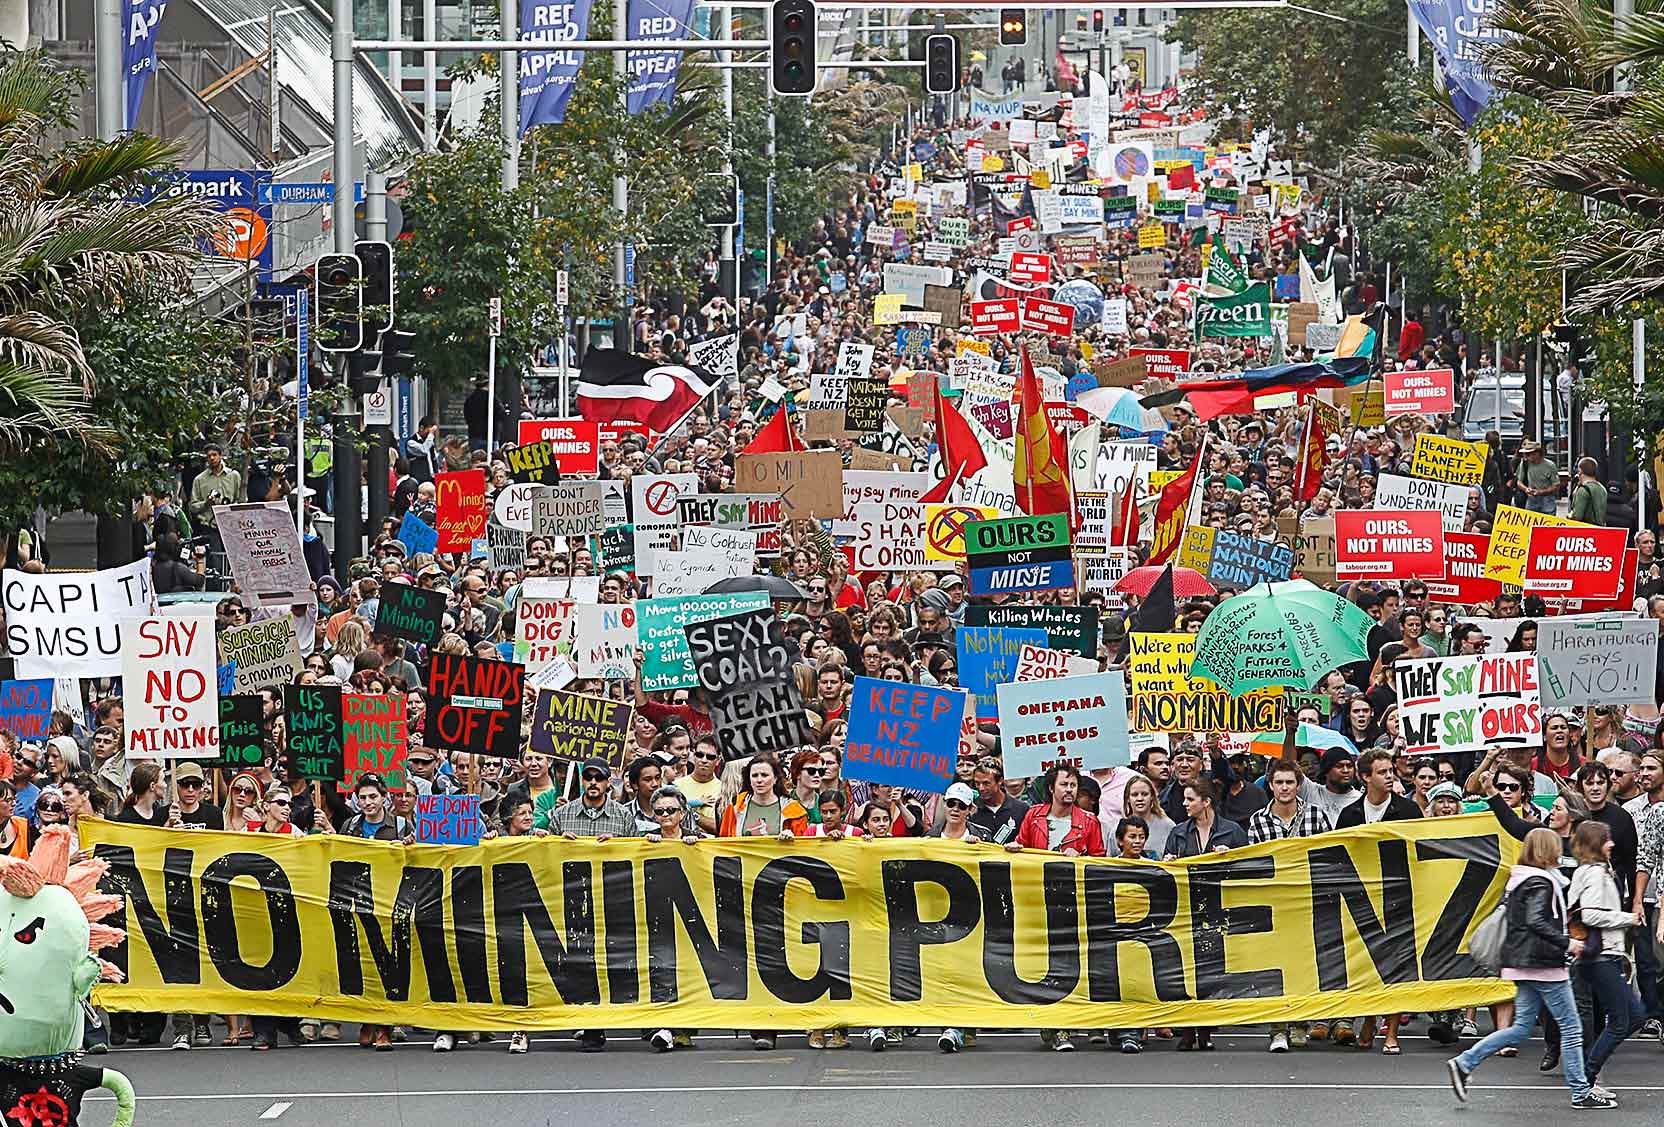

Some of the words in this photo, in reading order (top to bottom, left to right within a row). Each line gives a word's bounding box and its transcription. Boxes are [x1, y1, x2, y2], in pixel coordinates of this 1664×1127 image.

[640, 17, 677, 35] RED
[1159, 200, 1181, 209] OURS
[941, 221, 967, 230] OURS
[976, 314, 991, 323] NOT
[992, 312, 1015, 321] MINES
[984, 304, 1006, 313] OURS.
[1038, 304, 1061, 315] OURS.
[1029, 311, 1043, 319] NOT
[1044, 314, 1069, 325] MINES
[845, 345, 864, 355] John
[845, 356, 861, 371] Key
[1145, 355, 1172, 364] OURS.
[1153, 364, 1183, 374] MINES
[848, 381, 888, 395] NATIONAL
[1404, 376, 1434, 388] OURS.
[823, 388, 843, 400] NZ
[1391, 388, 1413, 399] NOT
[1414, 386, 1447, 398] MINES
[848, 408, 865, 419] GET
[869, 408, 884, 419] MY
[1047, 407, 1075, 418] OURS.
[855, 419, 879, 429] VOTE
[541, 428, 577, 440] OURS.
[552, 442, 591, 454] MINES
[1123, 446, 1156, 462] MINE
[1420, 437, 1472, 458] HEALTHY
[508, 442, 553, 474] KEEP
[1418, 450, 1464, 469] PLANET
[528, 470, 543, 481] IT
[1415, 462, 1467, 482] HEALTHY
[437, 480, 486, 510] Mining
[552, 487, 585, 499] DON'T
[539, 499, 600, 518] PLUNDER
[676, 498, 719, 523] THEY
[718, 503, 747, 524] SAY
[1091, 498, 1106, 507] THE
[1380, 492, 1464, 519] UNDERMINE
[539, 514, 603, 536] PARADISE
[978, 519, 1056, 549] OURS
[1089, 524, 1104, 533] THE
[1366, 519, 1413, 535] OURS.
[256, 540, 272, 548] OUR
[687, 529, 707, 545] No
[710, 532, 755, 551] Goldrush
[892, 539, 917, 547] THE
[1216, 530, 1268, 556] DON'T
[1347, 538, 1379, 553] NOT
[1381, 537, 1433, 553] MINES
[1496, 530, 1521, 544] THE
[1555, 537, 1597, 553] OURS.
[251, 549, 285, 557] NATIONAL
[1007, 552, 1032, 564] NOT
[1492, 545, 1526, 561] KEEP
[1086, 558, 1102, 567] SAVE
[1106, 558, 1121, 567] THE
[1214, 545, 1291, 581] NATIONAL
[1345, 562, 1388, 571] labour.org.nz
[1451, 562, 1485, 579] MINE
[1536, 555, 1566, 571] NOT
[1567, 556, 1613, 572] MINES
[1086, 568, 1123, 581] WORLD
[1211, 562, 1255, 586] RUIN
[402, 590, 426, 609] No
[646, 605, 679, 617] Move
[729, 597, 767, 609] tonnes
[520, 600, 576, 620] DON'T
[603, 607, 636, 630] NO
[673, 611, 687, 624] of
[988, 609, 1029, 626] Killing
[1030, 608, 1081, 624] Whales
[380, 604, 435, 643] Mining
[138, 620, 199, 659] SAY
[689, 614, 775, 657] SEXY
[1247, 628, 1285, 641] Forest
[641, 639, 654, 652] to
[659, 637, 679, 651] get
[1134, 661, 1163, 674] and
[1576, 651, 1623, 666] SAYS
[698, 645, 789, 692] COAL?
[1238, 669, 1306, 681] GENERATIONS
[144, 669, 206, 705] NO
[429, 655, 524, 705] HANDS
[1137, 680, 1174, 691] want
[1188, 678, 1204, 692] to
[1394, 661, 1442, 699] THEY
[1443, 664, 1476, 697] SAY
[1568, 663, 1640, 695] NO!!
[299, 689, 324, 711] US
[347, 695, 403, 717] DON'T
[717, 684, 795, 724] YEAH
[870, 687, 951, 722] KEEP
[1017, 695, 1106, 717] ONEMANA
[153, 705, 188, 724] TO
[549, 694, 618, 728] MINE
[437, 705, 511, 751] OFF
[543, 718, 598, 738] national
[1055, 715, 1065, 727] 2
[1403, 713, 1440, 746] WE
[1443, 708, 1476, 743] SAY
[129, 725, 220, 752] MINING
[343, 720, 405, 745] MINE
[718, 709, 807, 755] RIGHT
[877, 718, 920, 748] NZ
[1014, 726, 1099, 748] PRECIOUS
[290, 736, 326, 755] GIVE
[327, 737, 342, 754] A
[1057, 745, 1067, 757] 2
[296, 757, 335, 776] SHIT
[358, 746, 396, 769] MY
[847, 740, 952, 778] BEAUTIFUL
[418, 798, 441, 816] WE
[443, 796, 479, 815] DON'T
[455, 818, 478, 841] IT!
[93, 842, 304, 991] NO
[329, 855, 852, 1006] MINING
[880, 855, 1286, 1005] PURE
[1307, 834, 1504, 993] NZ
